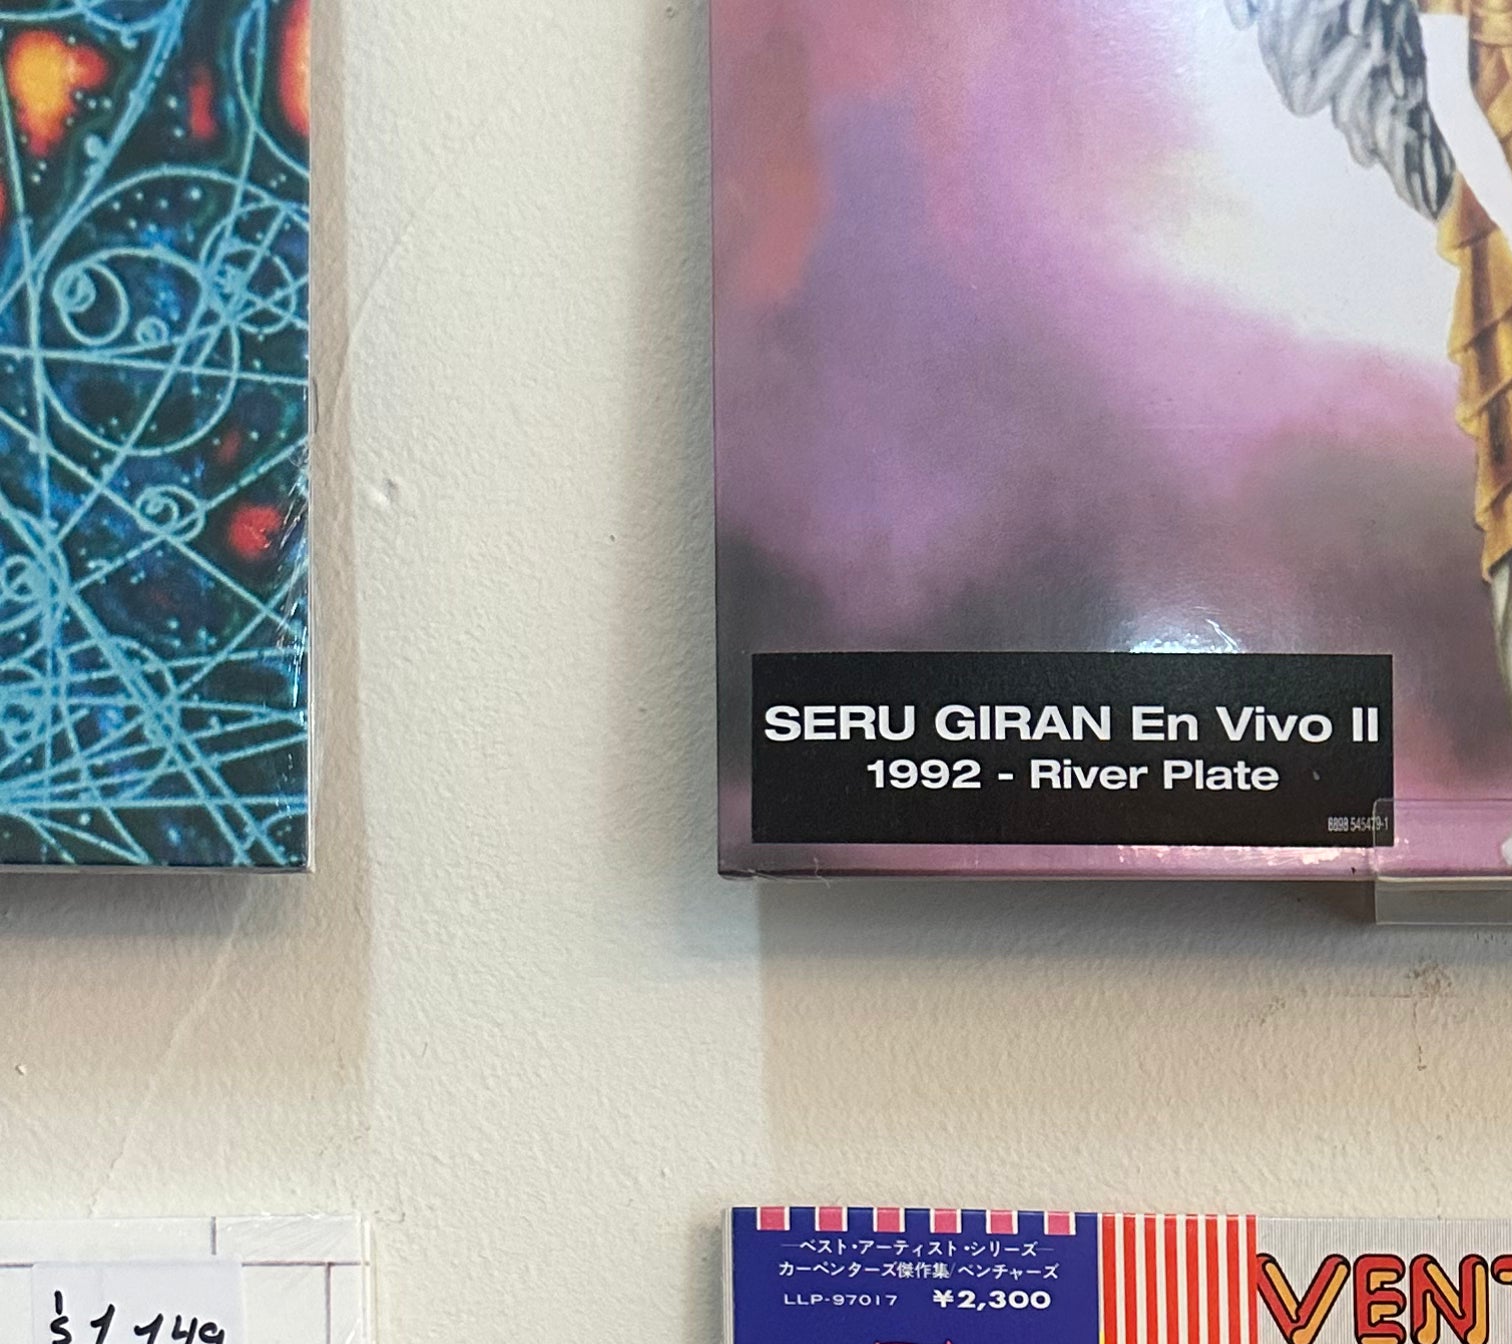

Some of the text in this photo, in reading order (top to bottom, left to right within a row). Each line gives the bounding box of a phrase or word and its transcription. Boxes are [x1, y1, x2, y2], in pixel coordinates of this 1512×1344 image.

[763, 704, 1379, 743] SERU GIRAN En Vivo II
[865, 760, 982, 790] 1992
[1030, 759, 1149, 790] River
[1163, 760, 1280, 791] Plate
[784, 1289, 1051, 1311] LLP-97017 ¥2,300
